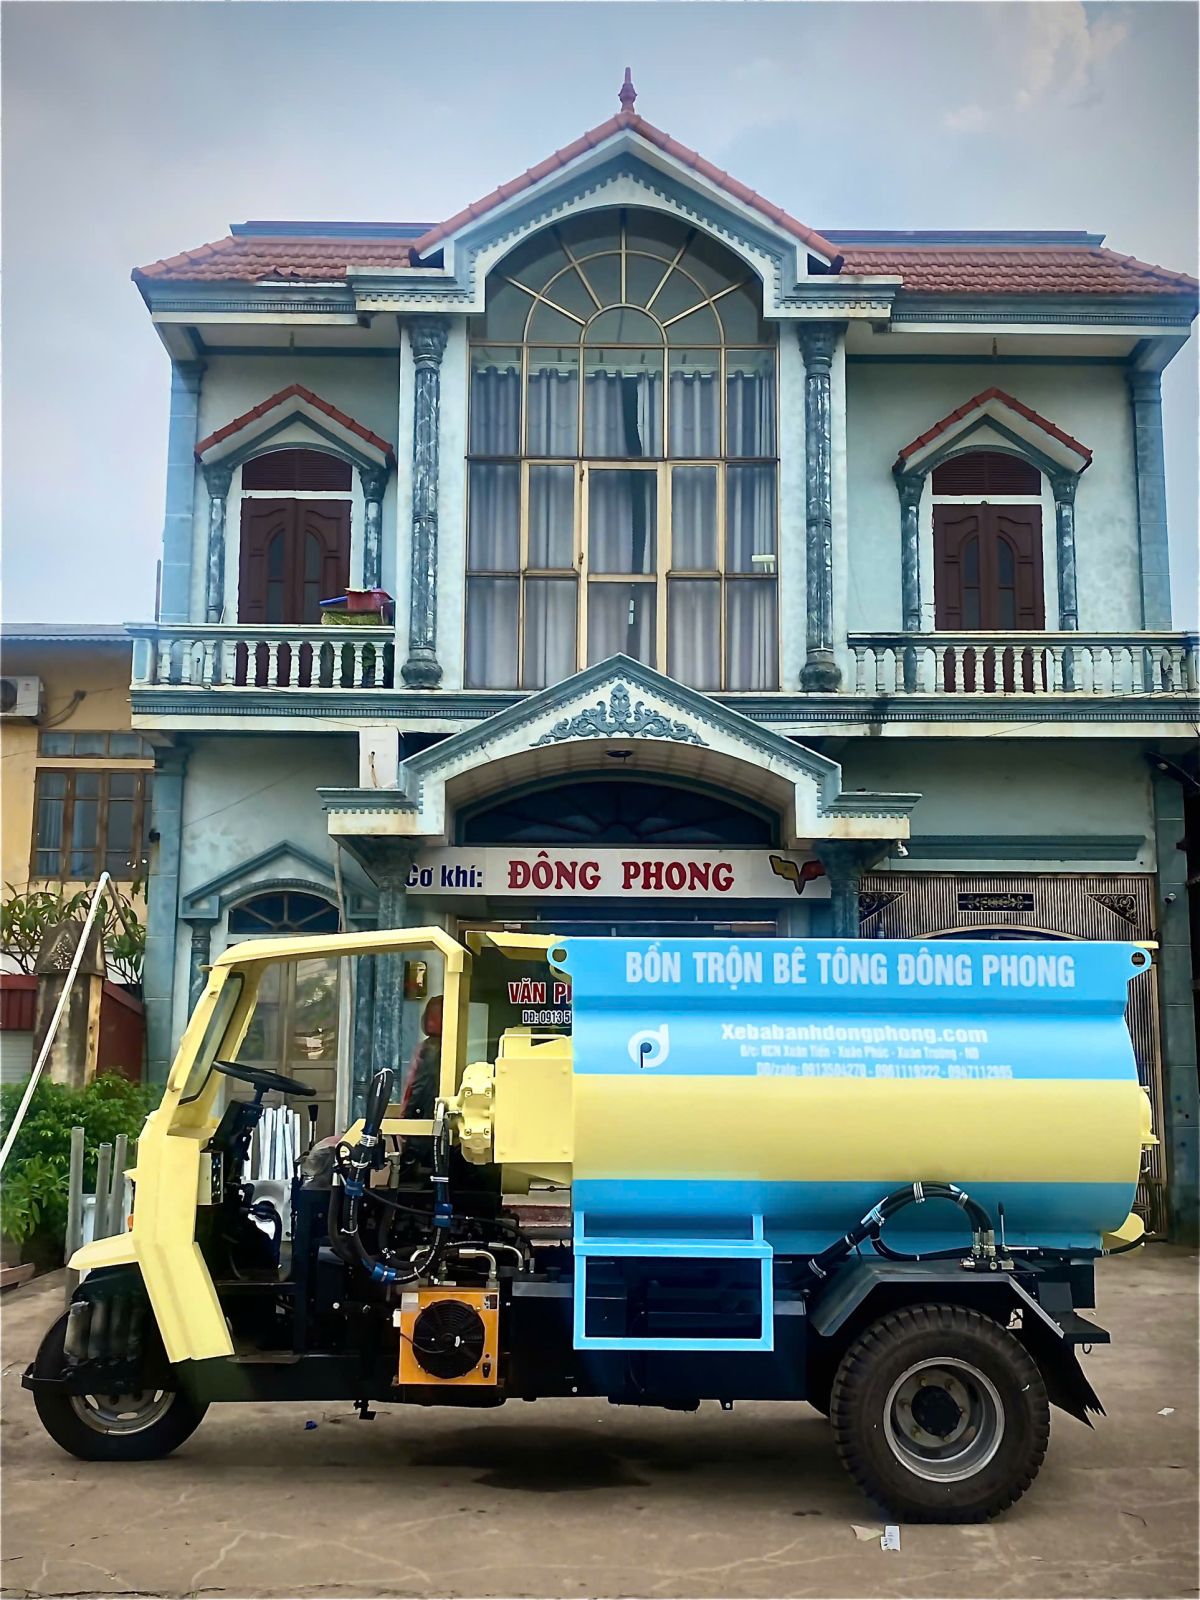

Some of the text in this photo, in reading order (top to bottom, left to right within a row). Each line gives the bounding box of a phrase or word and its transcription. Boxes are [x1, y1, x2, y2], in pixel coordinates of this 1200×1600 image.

[405, 864, 482, 888] Cơ khí:
[508, 851, 734, 891] ĐÔNG PHONG
[626, 942, 1075, 990] BỒN TRỘN BÊ TÔNG ĐÔNG PHONG
[508, 978, 546, 1004] VĂN
[721, 1023, 988, 1044] Xebabanhdongphong.com
